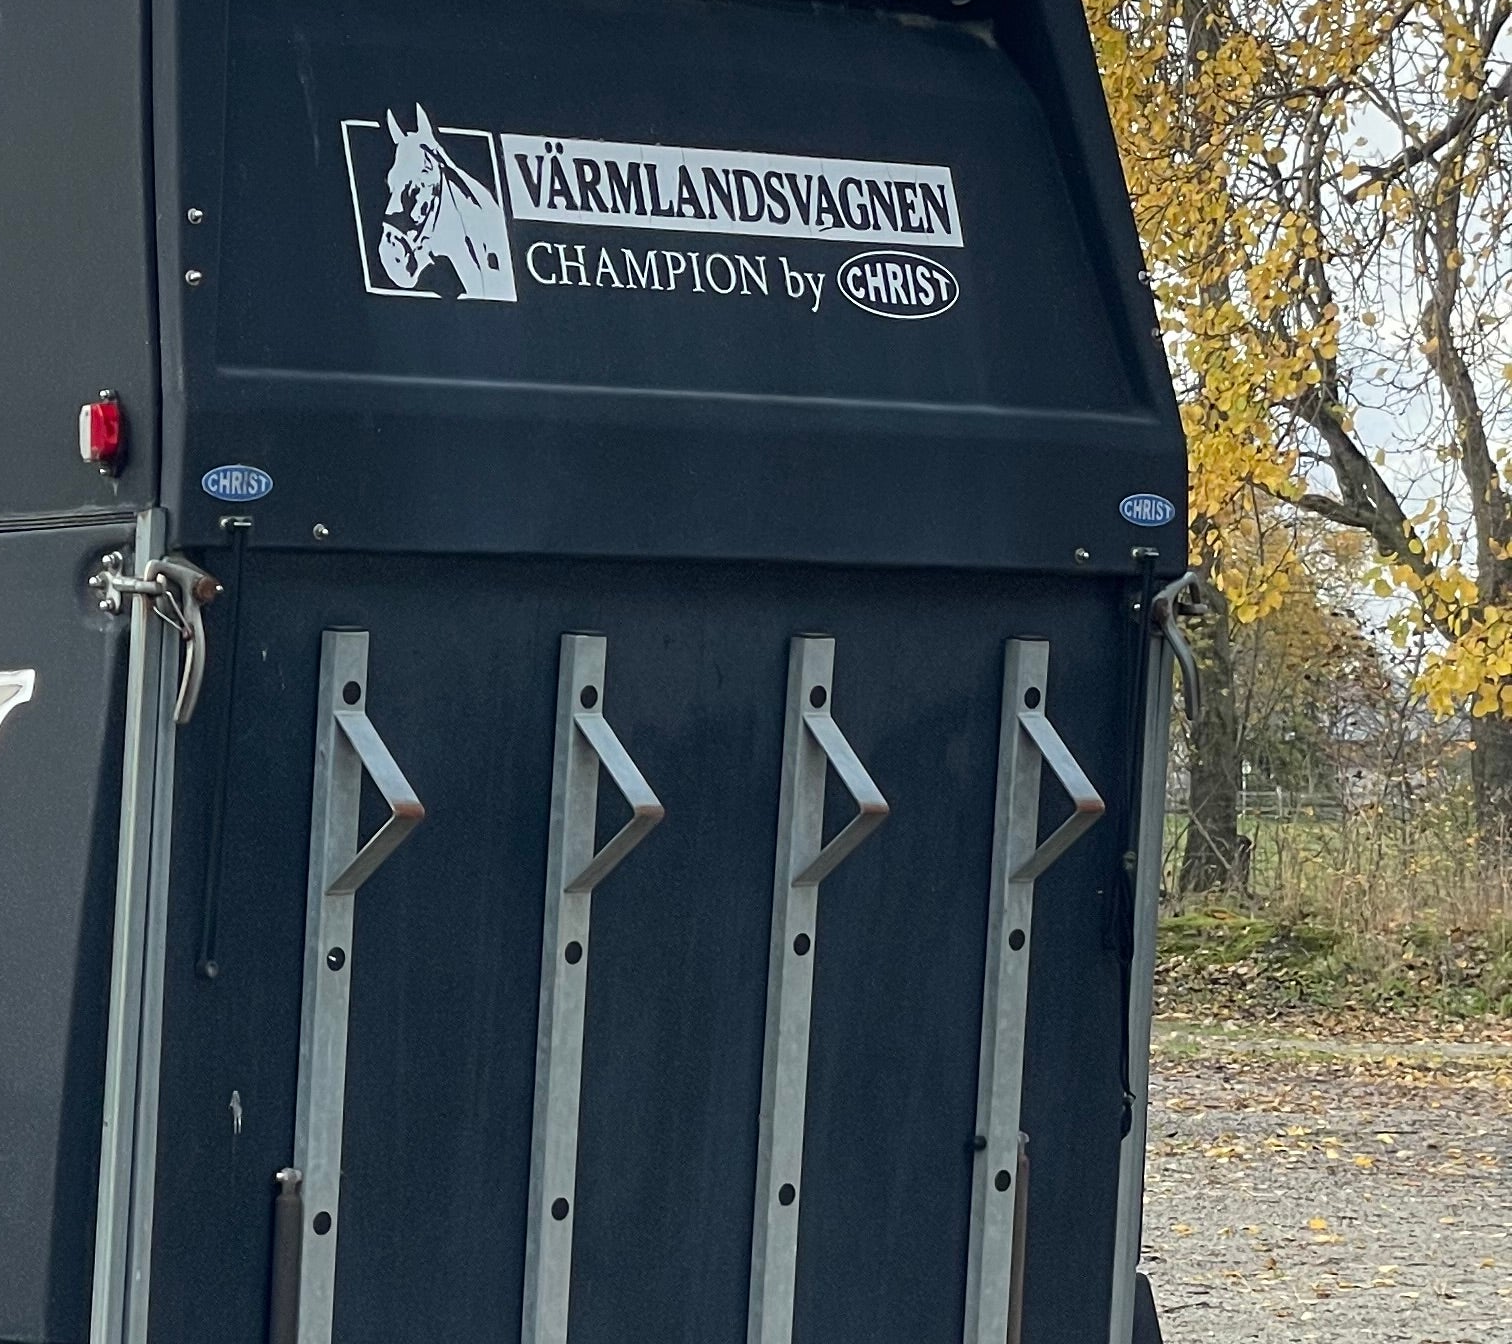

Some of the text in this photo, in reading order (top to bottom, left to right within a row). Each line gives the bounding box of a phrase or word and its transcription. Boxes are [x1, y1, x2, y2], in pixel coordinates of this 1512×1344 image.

[514, 141, 953, 235] VÄRMLANDSVAGNEN
[526, 241, 951, 312] CHAMPION by CHRIST
[207, 470, 268, 495] CHRIST
[1123, 498, 1173, 521] CHRIST
